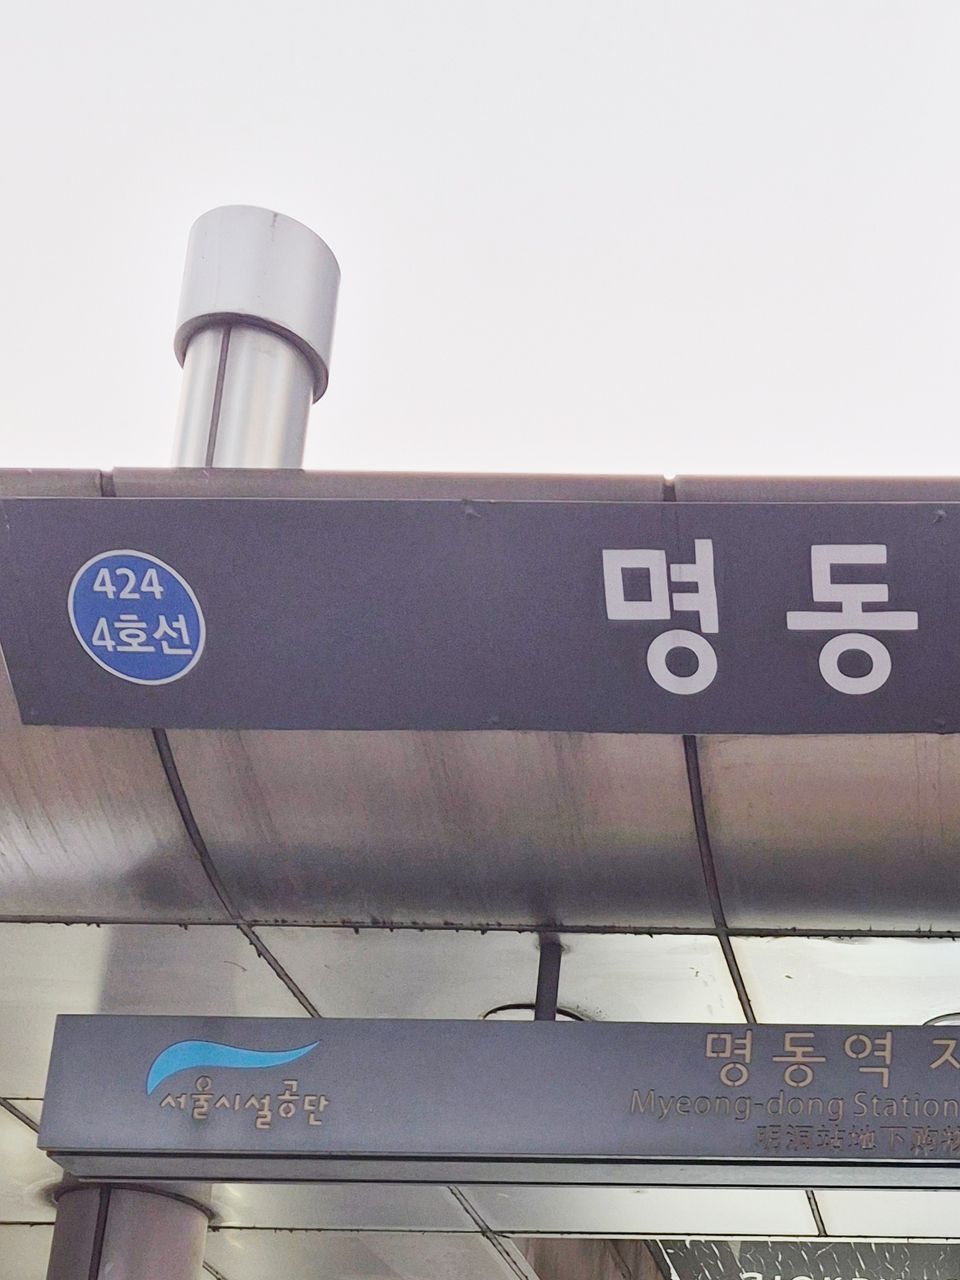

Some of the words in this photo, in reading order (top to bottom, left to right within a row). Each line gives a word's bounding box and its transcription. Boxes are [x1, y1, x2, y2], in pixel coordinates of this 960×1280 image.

[93, 567, 164, 600] 424
[91, 614, 193, 655] 4호선
[160, 1075, 329, 1129] 서울시설공단
[630, 1089, 844, 1121] Myeong-dong
[854, 1091, 959, 1118] Station
